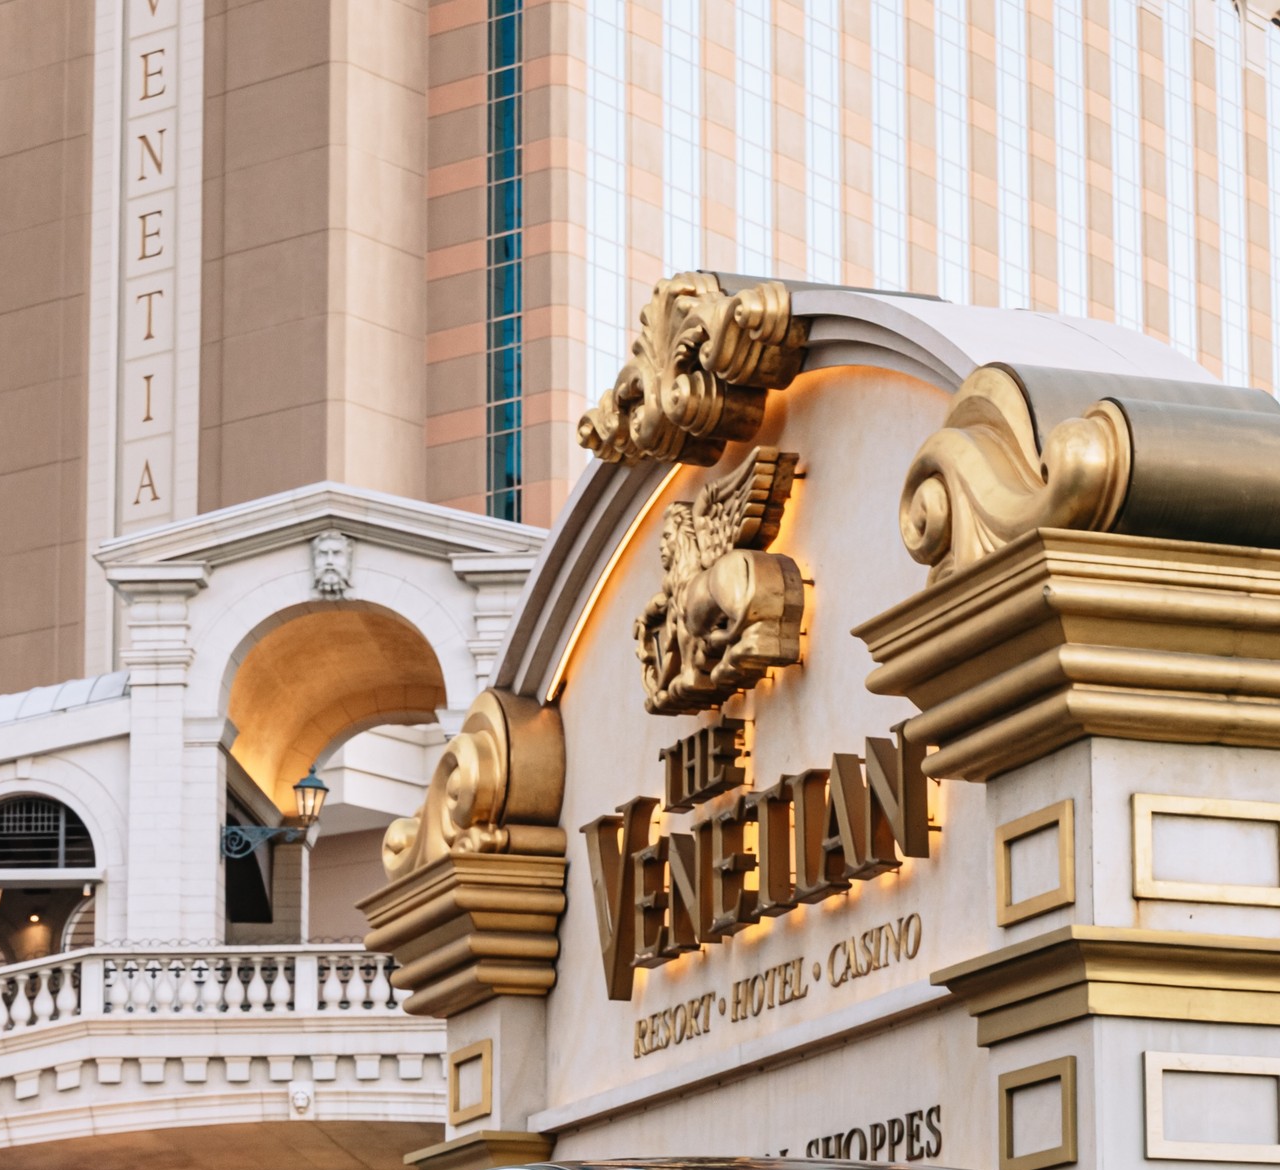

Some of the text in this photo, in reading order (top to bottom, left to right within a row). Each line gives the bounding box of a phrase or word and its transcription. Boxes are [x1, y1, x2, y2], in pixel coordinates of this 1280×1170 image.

[659, 715, 747, 813] THE
[580, 718, 930, 1001] VENETIAN
[634, 912, 923, 1059] RESORT HOTEL CASINO
